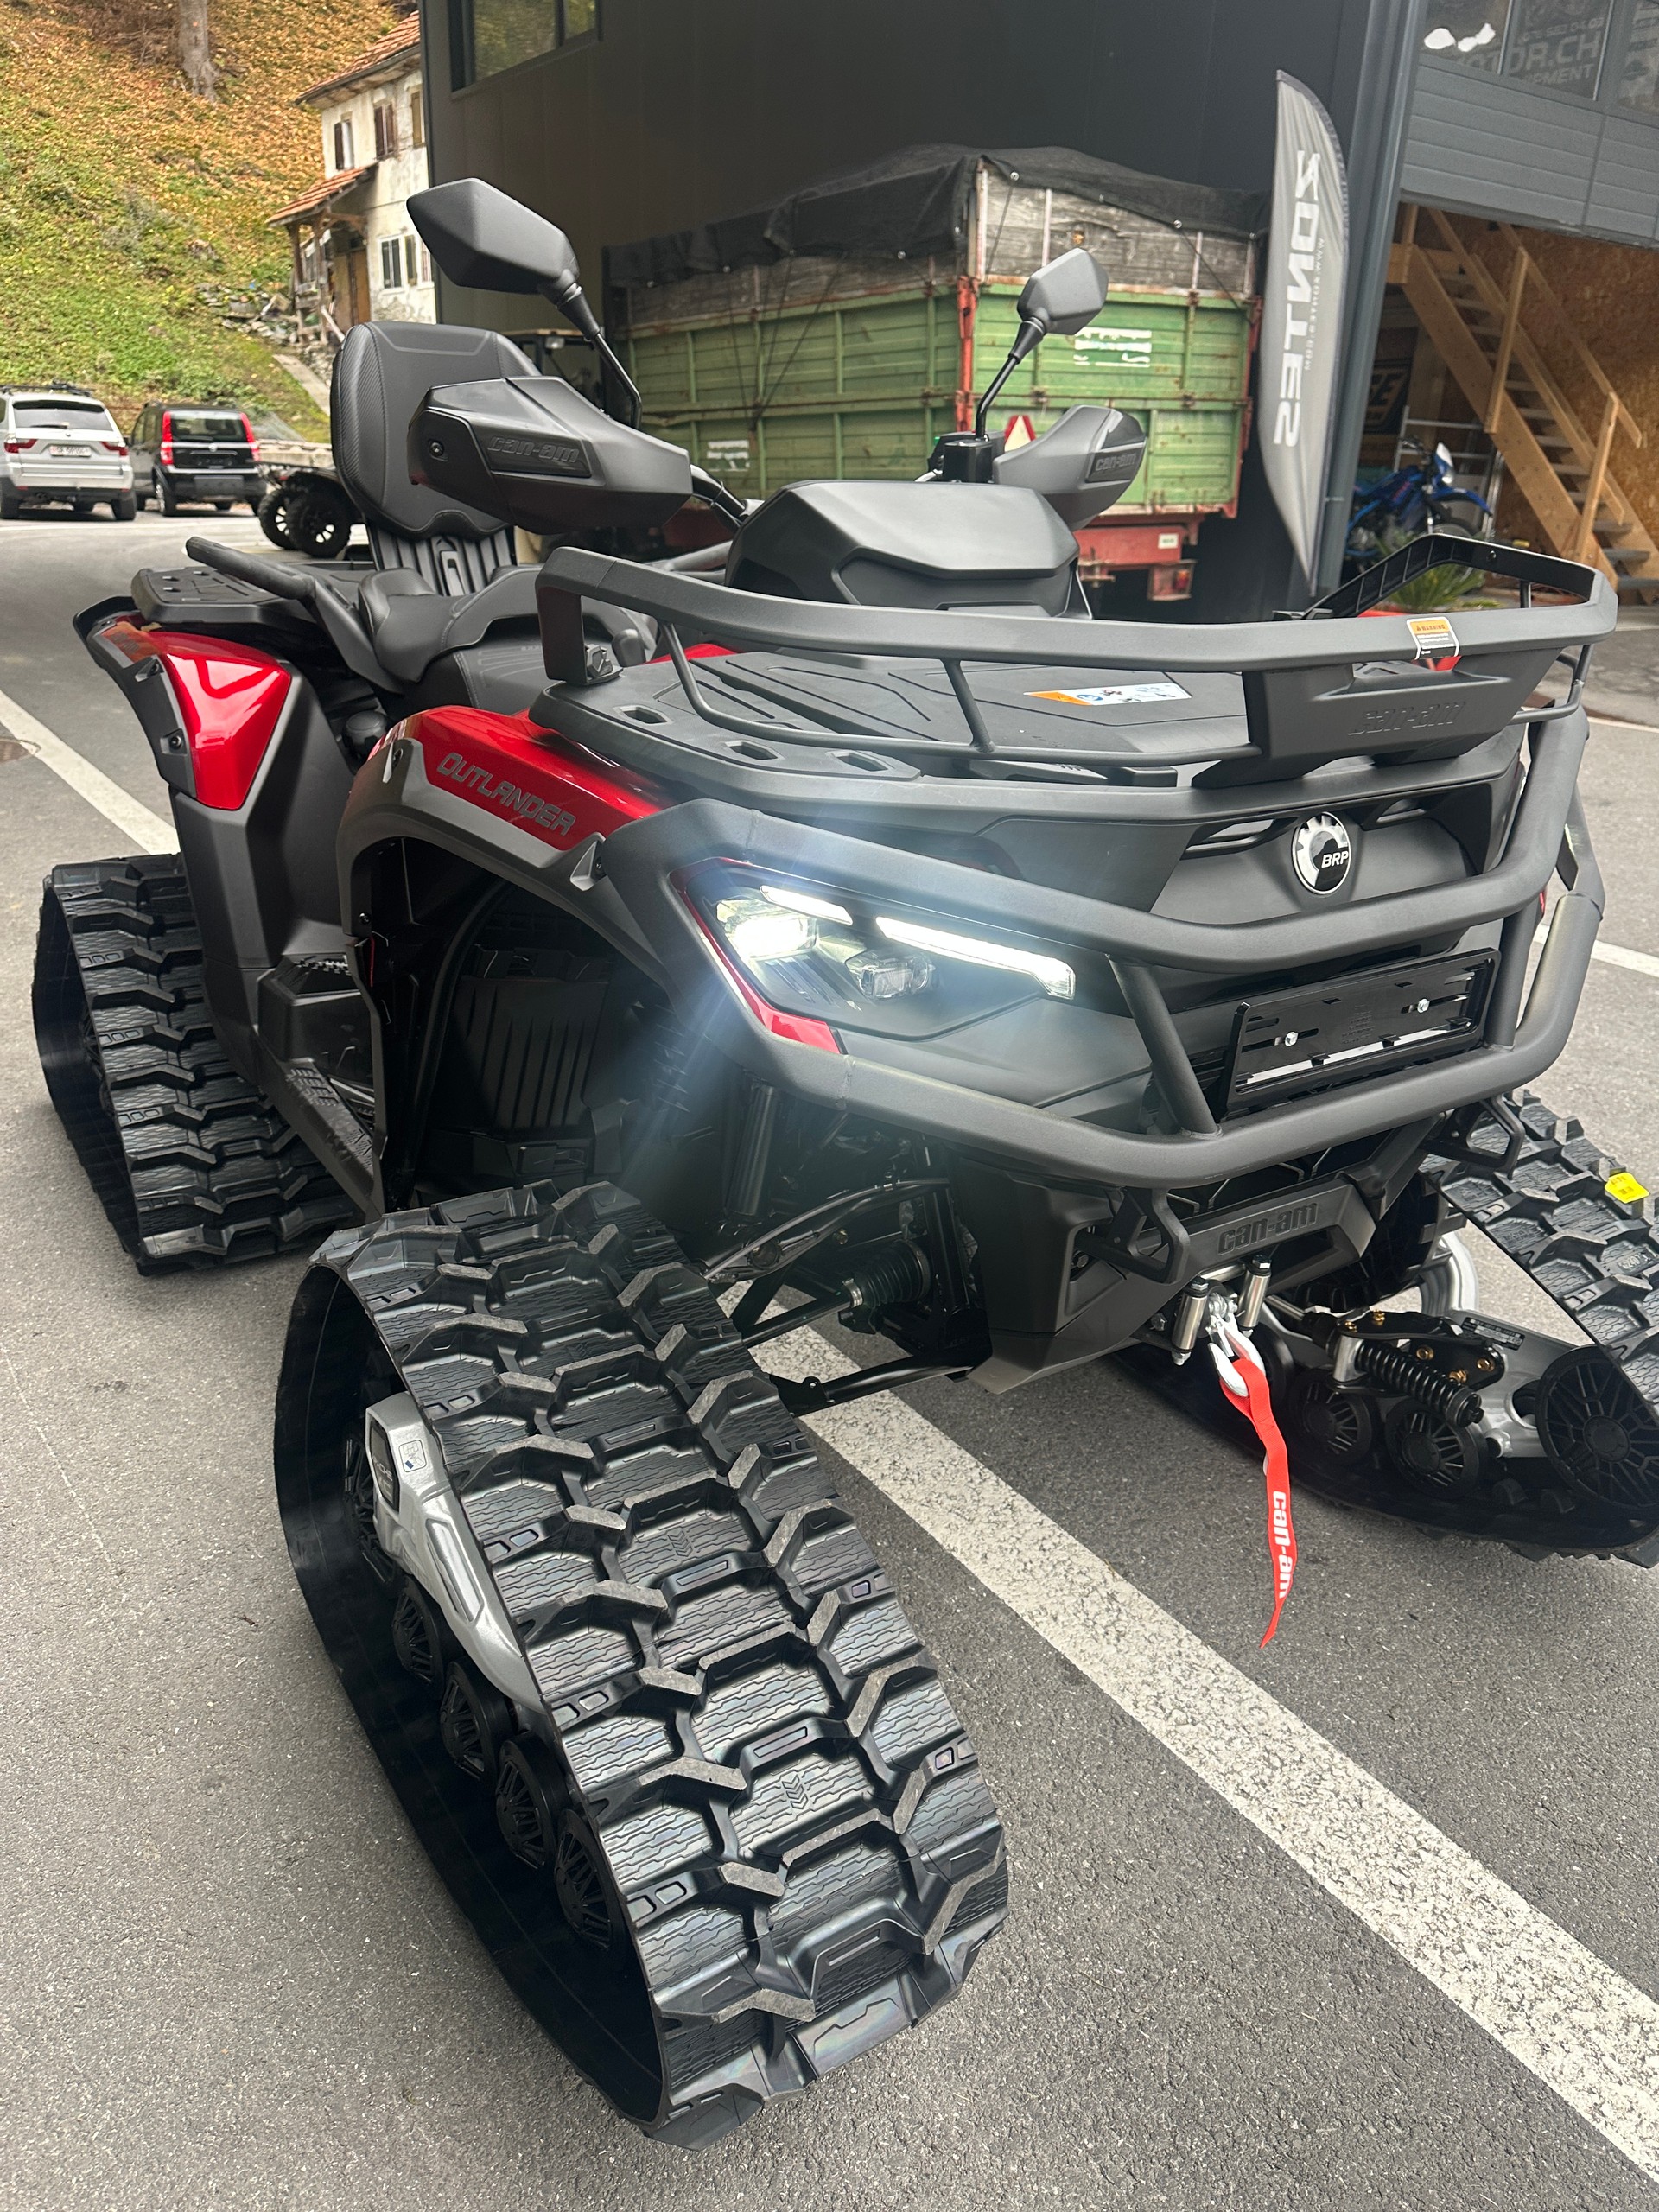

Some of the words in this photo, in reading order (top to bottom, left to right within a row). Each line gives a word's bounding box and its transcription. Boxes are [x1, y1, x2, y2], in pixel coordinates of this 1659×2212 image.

[487, 436, 580, 463] can-am
[1095, 452, 1138, 472] can-am
[436, 752, 576, 836] OUTLANDER
[1321, 851, 1349, 868] BRP
[1218, 1202, 1318, 1255] can-am
